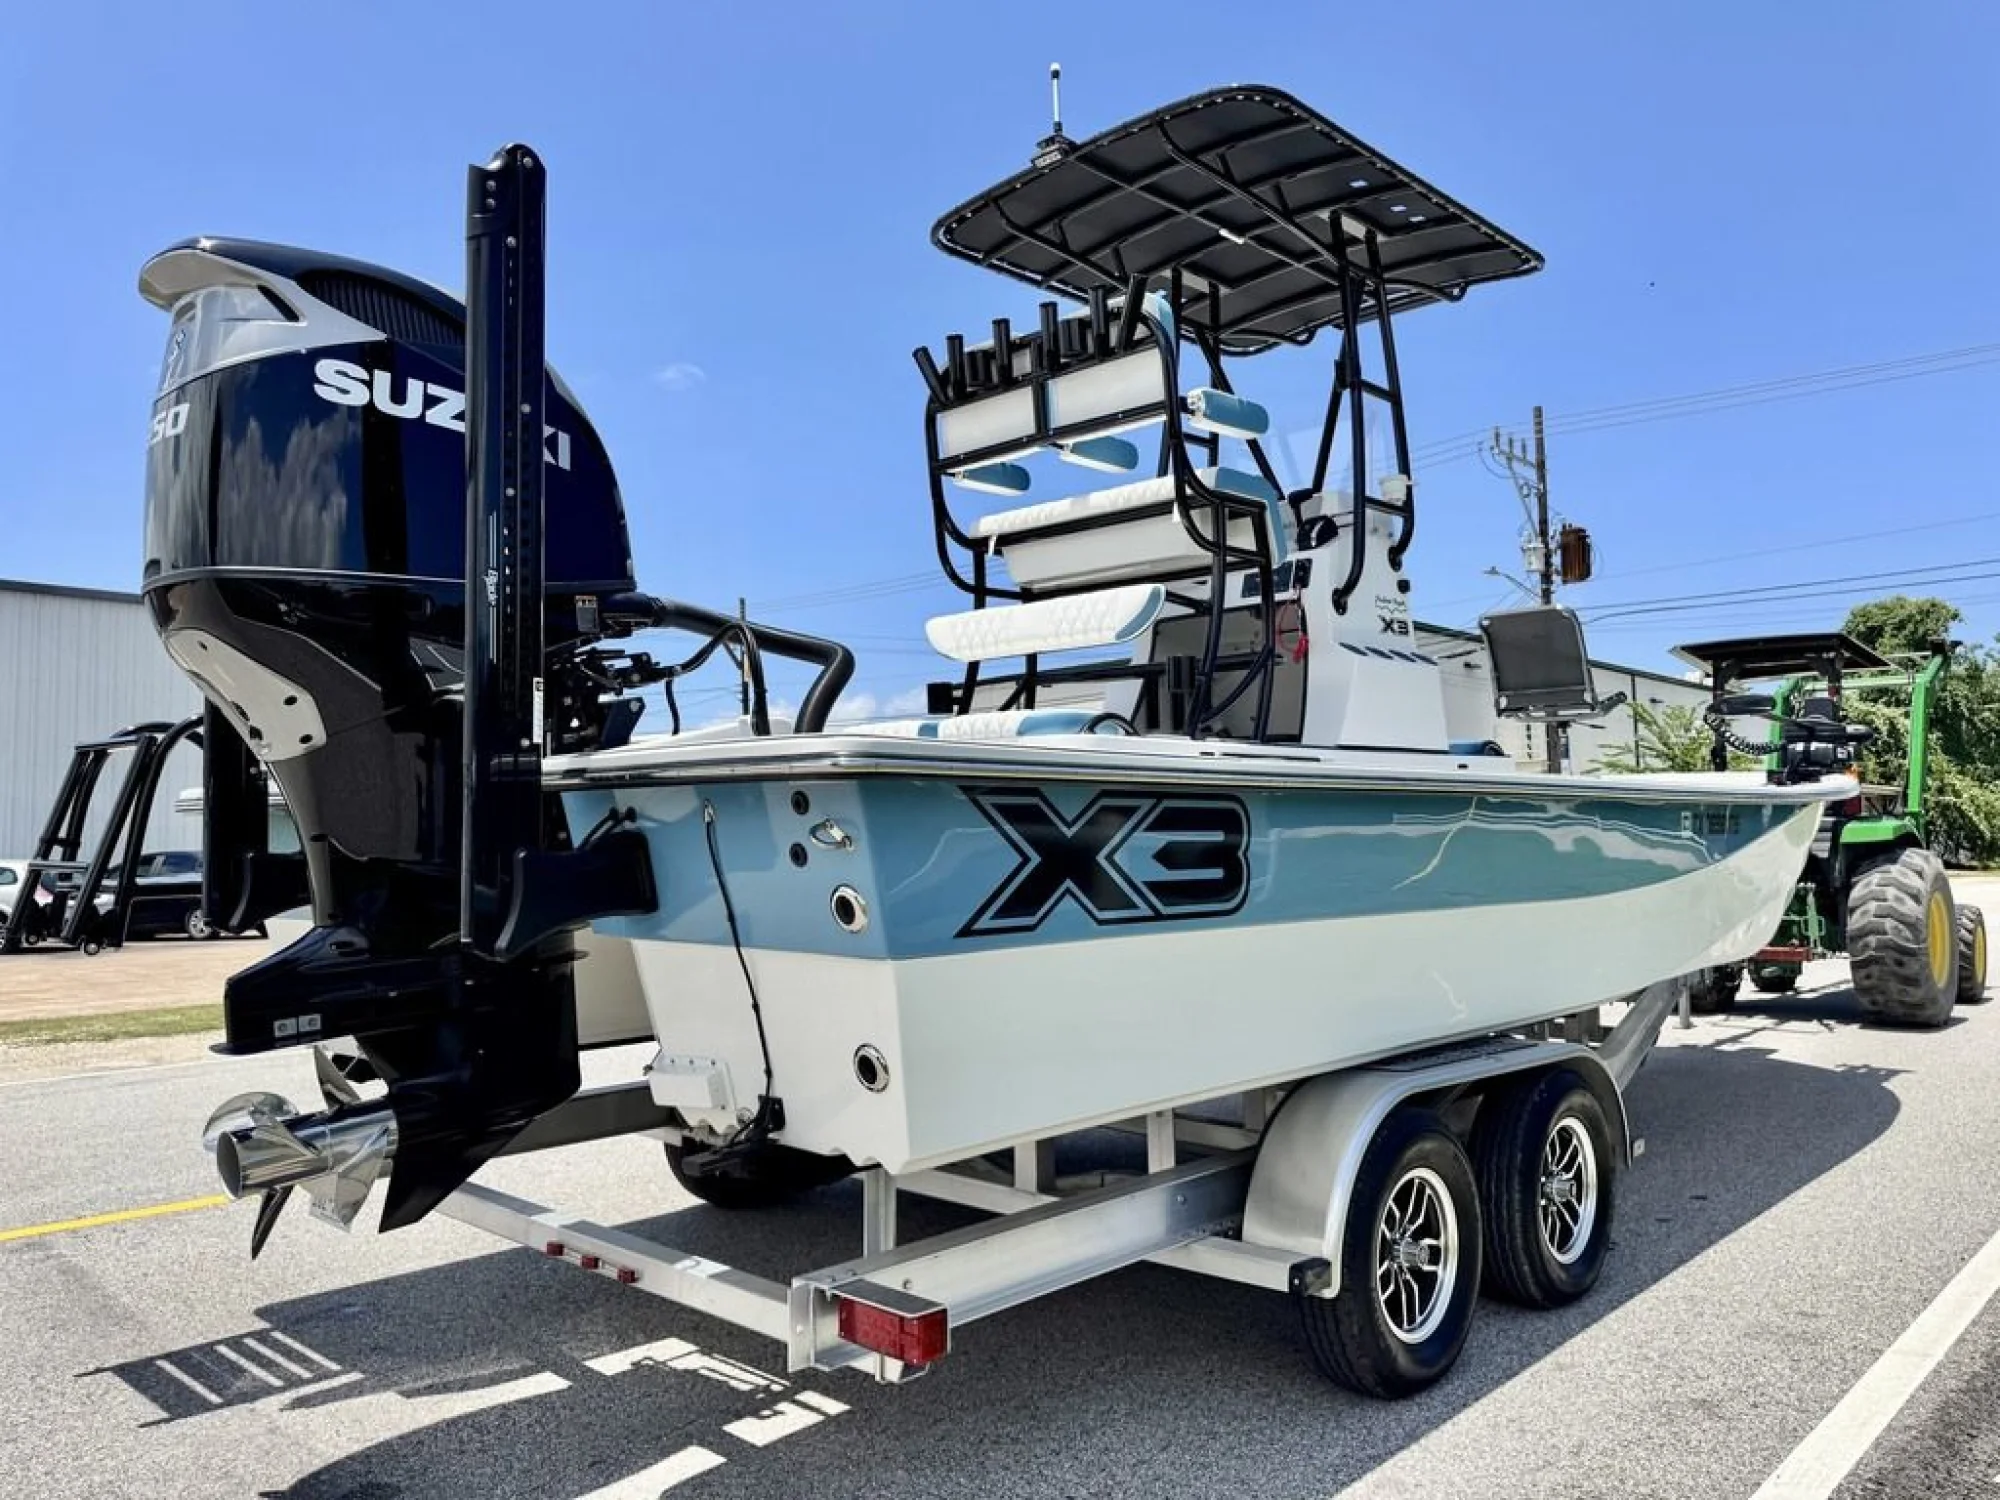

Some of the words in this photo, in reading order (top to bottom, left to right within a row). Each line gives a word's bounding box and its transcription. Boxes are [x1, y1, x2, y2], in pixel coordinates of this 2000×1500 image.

[314, 358, 571, 471] SUZI
[1376, 614, 1410, 637] X3
[953, 784, 1252, 938] X3
